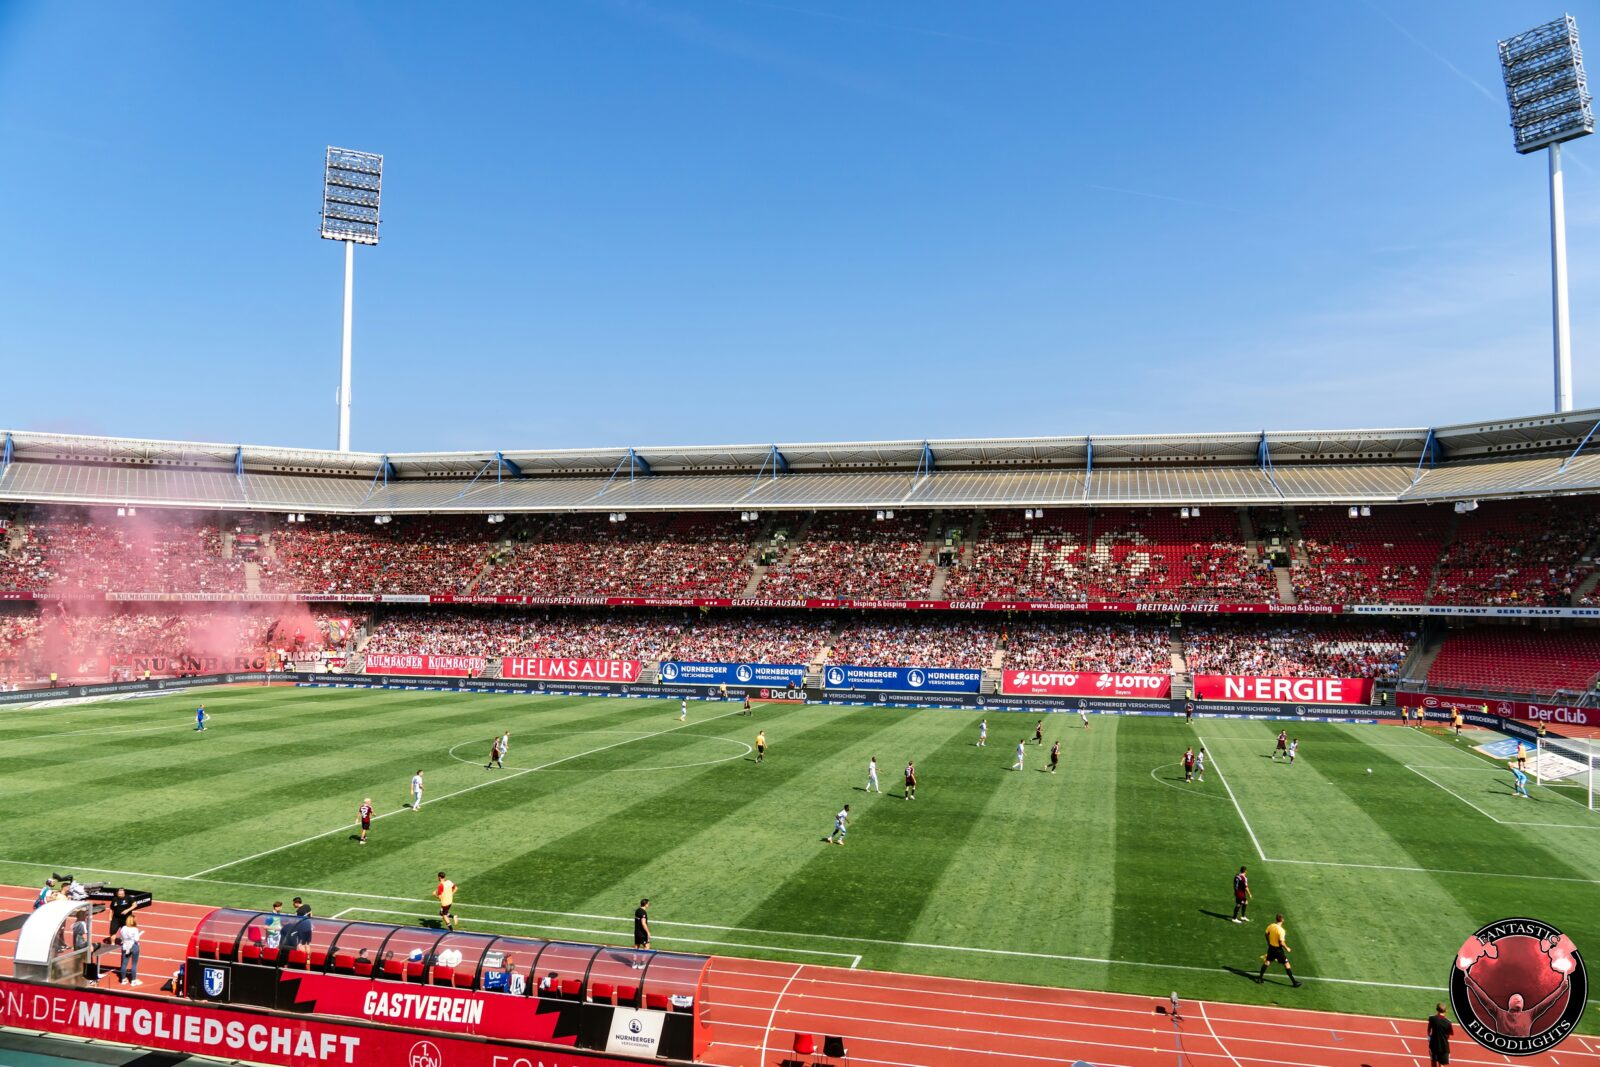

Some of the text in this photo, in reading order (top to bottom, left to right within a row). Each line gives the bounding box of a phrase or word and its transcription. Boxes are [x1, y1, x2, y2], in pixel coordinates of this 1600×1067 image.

[853, 600, 877, 608] bisping
[883, 601, 906, 609] bisping
[1136, 604, 1219, 612] BREITBAND-NETZE
[1269, 604, 1296, 613] bisping
[1305, 604, 1332, 613] bisping
[367, 654, 422, 668] KULMBACHER
[428, 656, 486, 669] KULMBACHER
[512, 659, 632, 679] HELMSAUER
[681, 665, 728, 674] NÜRNBERGER
[755, 668, 803, 676] NÜRNBERGER
[848, 670, 898, 678] NÜRNBERGER
[928, 672, 980, 680] NÜRNBERGER
[1032, 674, 1076, 686] LOTTO
[1116, 676, 1161, 688] LOTTO
[771, 690, 807, 699] Der Club
[1529, 705, 1587, 724] Der Club
[363, 990, 484, 1024] GASTVEREIN
[616, 1034, 655, 1044] NÜRNBERGER
[412, 1056, 438, 1067] FCN
